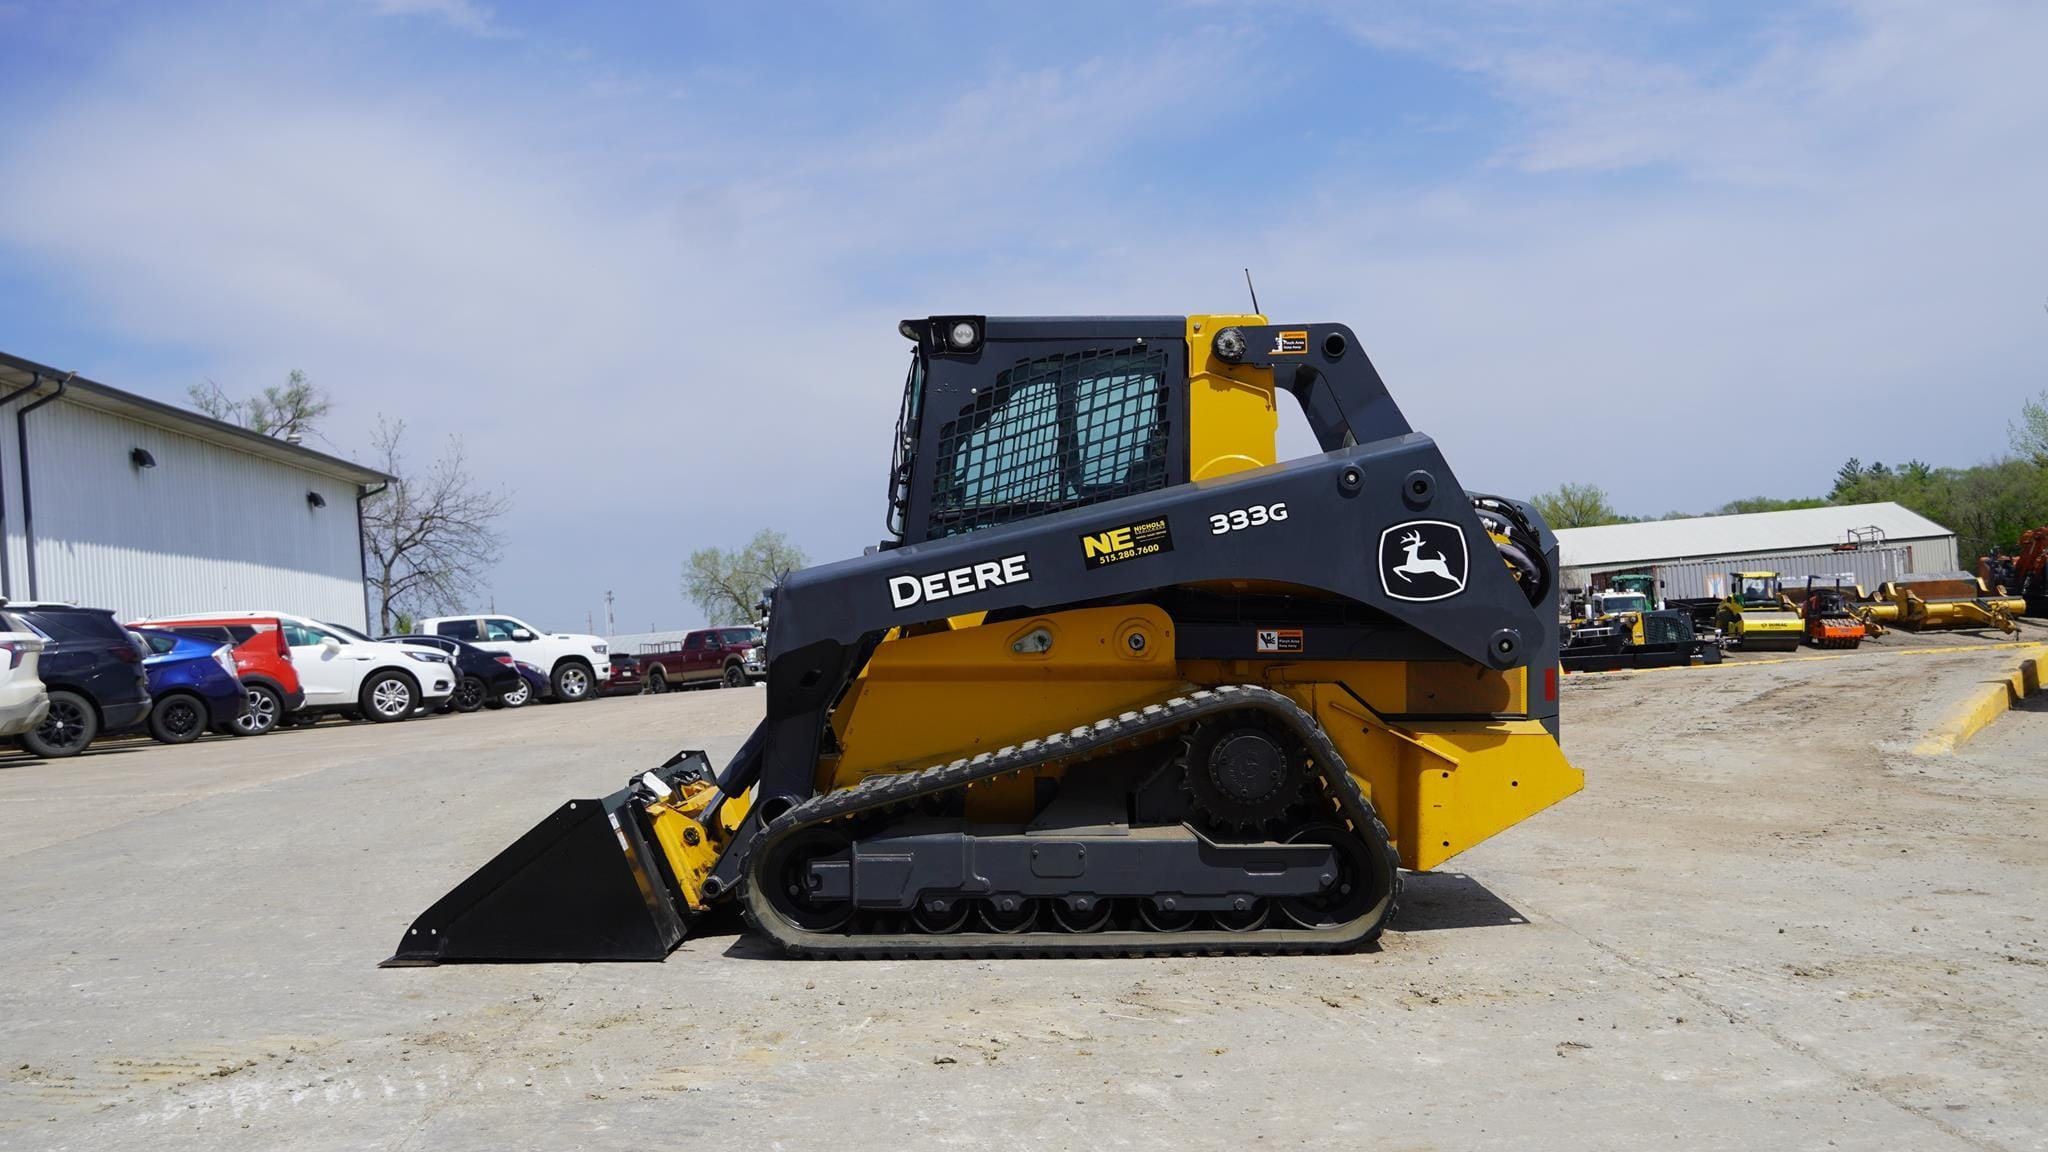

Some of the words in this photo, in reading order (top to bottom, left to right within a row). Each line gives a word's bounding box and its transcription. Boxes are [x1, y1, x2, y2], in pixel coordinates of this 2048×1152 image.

[1133, 520, 1165, 532] NICHOLS
[1209, 502, 1288, 535] 333G
[1083, 527, 1134, 558] NE
[1099, 544, 1159, 564] 515.280.7600
[889, 555, 1030, 608] DEERE
